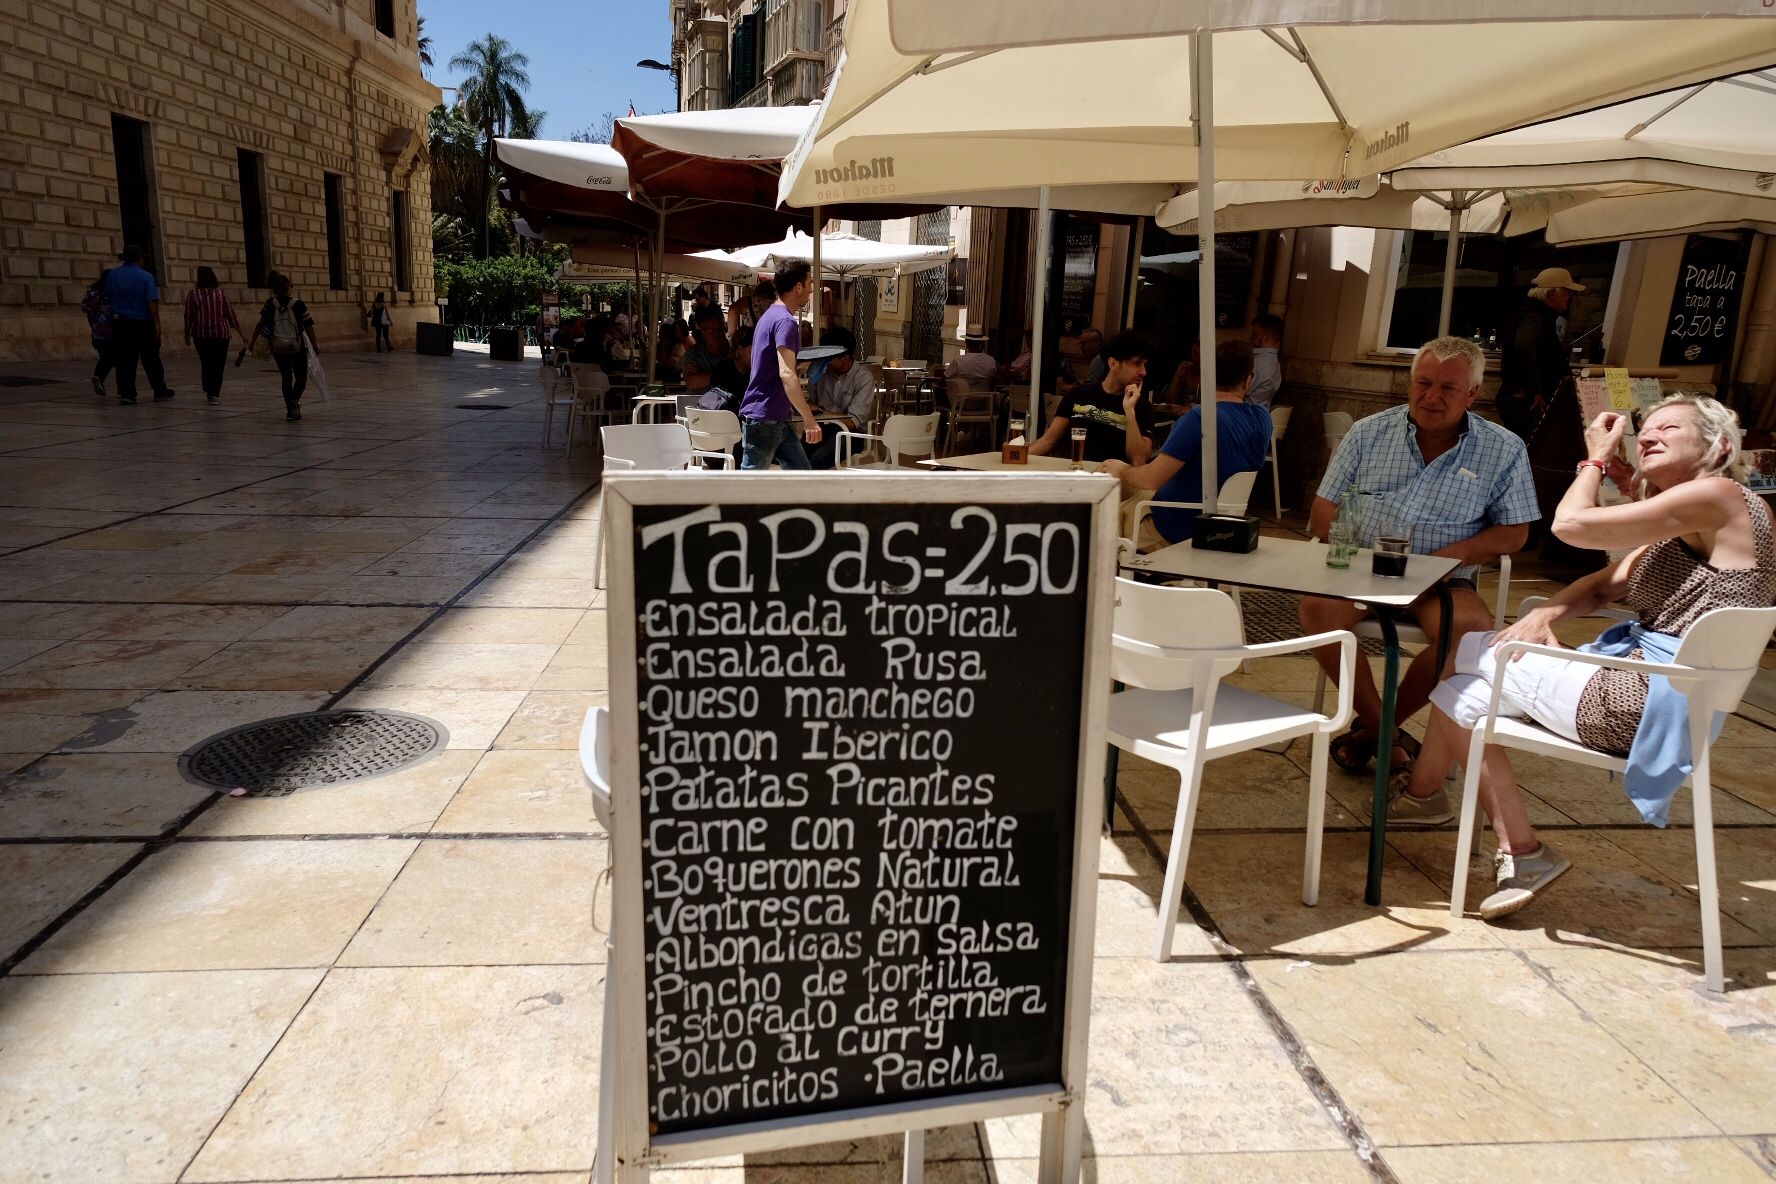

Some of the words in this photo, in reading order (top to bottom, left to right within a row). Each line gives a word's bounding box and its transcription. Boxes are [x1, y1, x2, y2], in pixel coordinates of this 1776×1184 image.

[1685, 264, 1736, 290] Paella
[1685, 292, 1711, 315] tapa
[1717, 296, 1725, 309] a
[1671, 314, 1712, 340] 2,50
[1713, 315, 1726, 338] €
[645, 595, 847, 638] Ensalada
[646, 638, 846, 681] Ensalada
[881, 637, 987, 682] Rusa
[646, 685, 759, 723] Queso
[647, 722, 778, 765] Jamon
[802, 722, 953, 761] Iberico
[645, 763, 809, 815] Patatas
[826, 763, 996, 807] Picantes
[649, 816, 768, 858] Carne
[790, 816, 855, 851] con
[877, 808, 1018, 850] tomate
[651, 856, 861, 899] Boquerones
[877, 851, 1021, 889] Natural
[652, 892, 850, 936] Ventresca
[870, 888, 960, 926] Atun
[877, 927, 920, 957] en
[652, 965, 781, 1015] Pincho
[802, 960, 847, 997] de
[862, 955, 999, 993] tortilla
[855, 992, 898, 1025] de
[908, 984, 1048, 1022] ternera
[657, 1066, 839, 1122] Choricitos
[873, 1045, 1005, 1094] Paella
